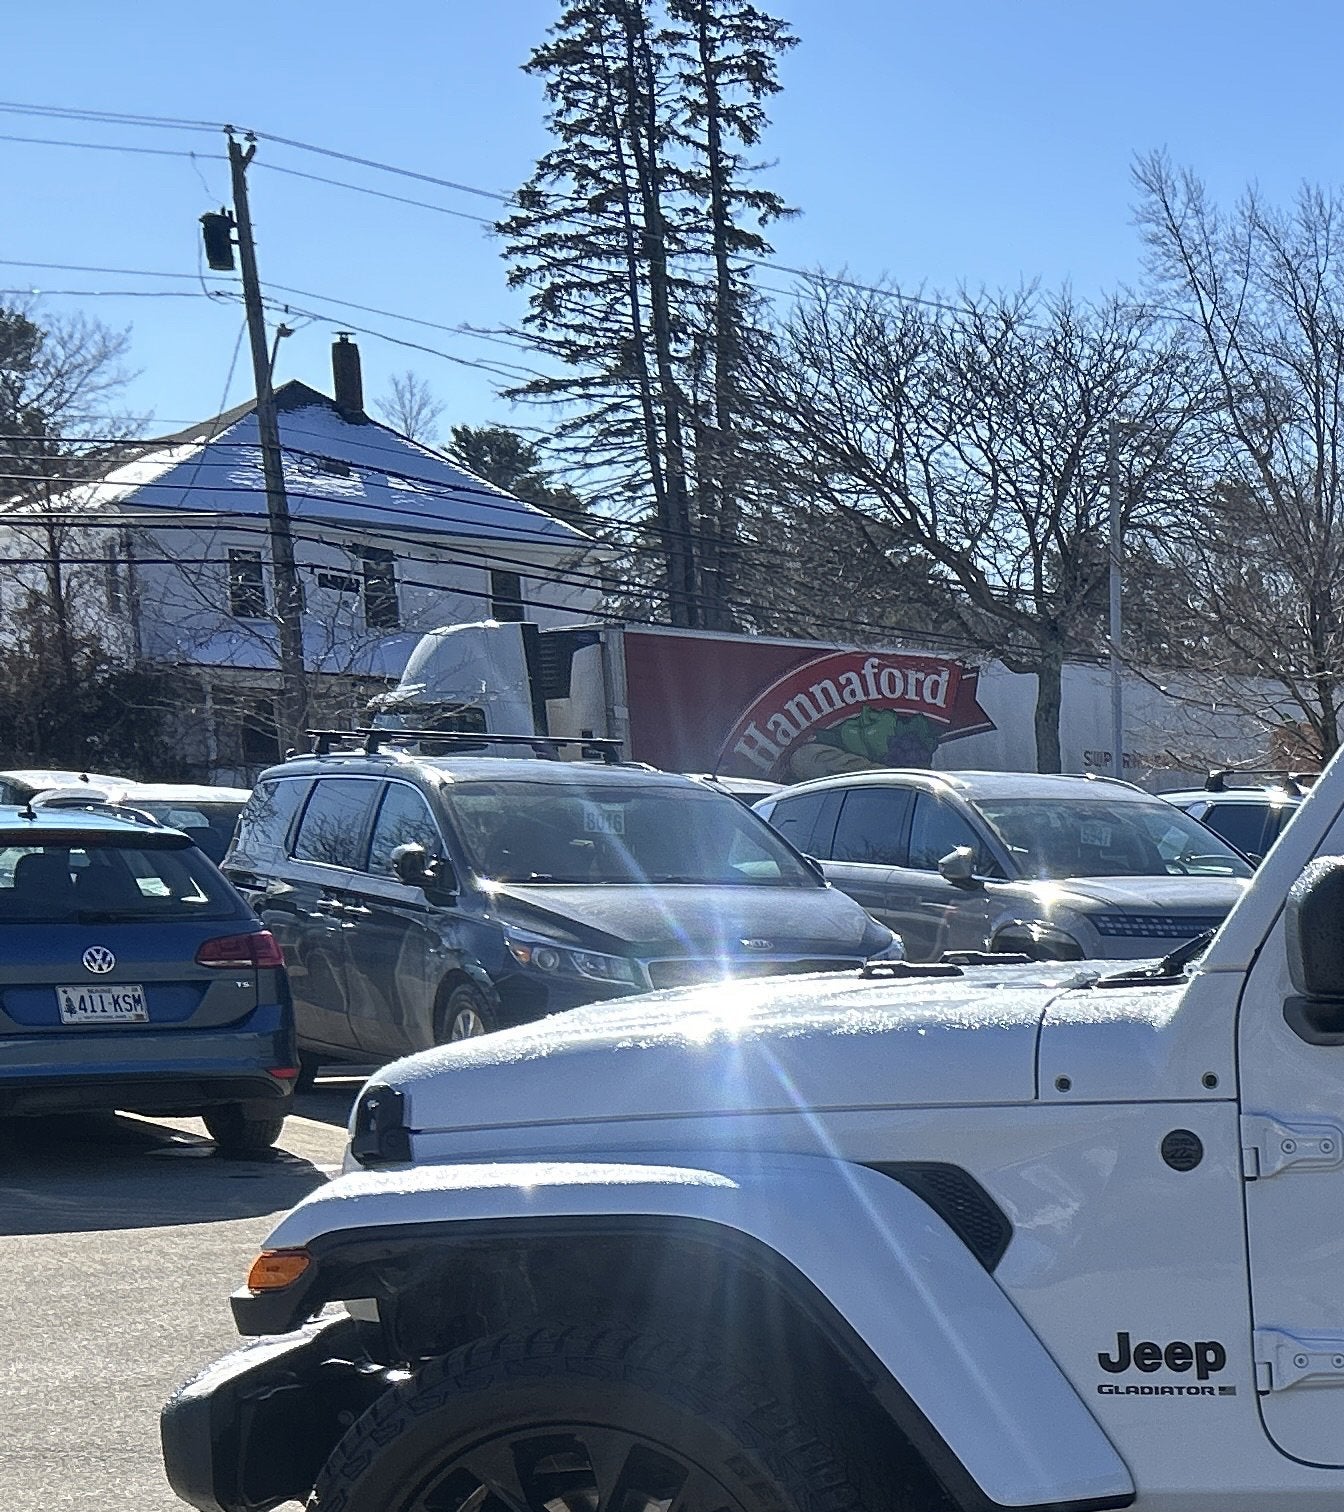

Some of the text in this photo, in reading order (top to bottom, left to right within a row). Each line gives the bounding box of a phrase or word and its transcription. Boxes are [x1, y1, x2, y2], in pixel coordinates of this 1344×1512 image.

[734, 657, 949, 772] Hannaford
[1098, 1332, 1226, 1380] Jeep
[1097, 1384, 1216, 1396] GLADIATOR
